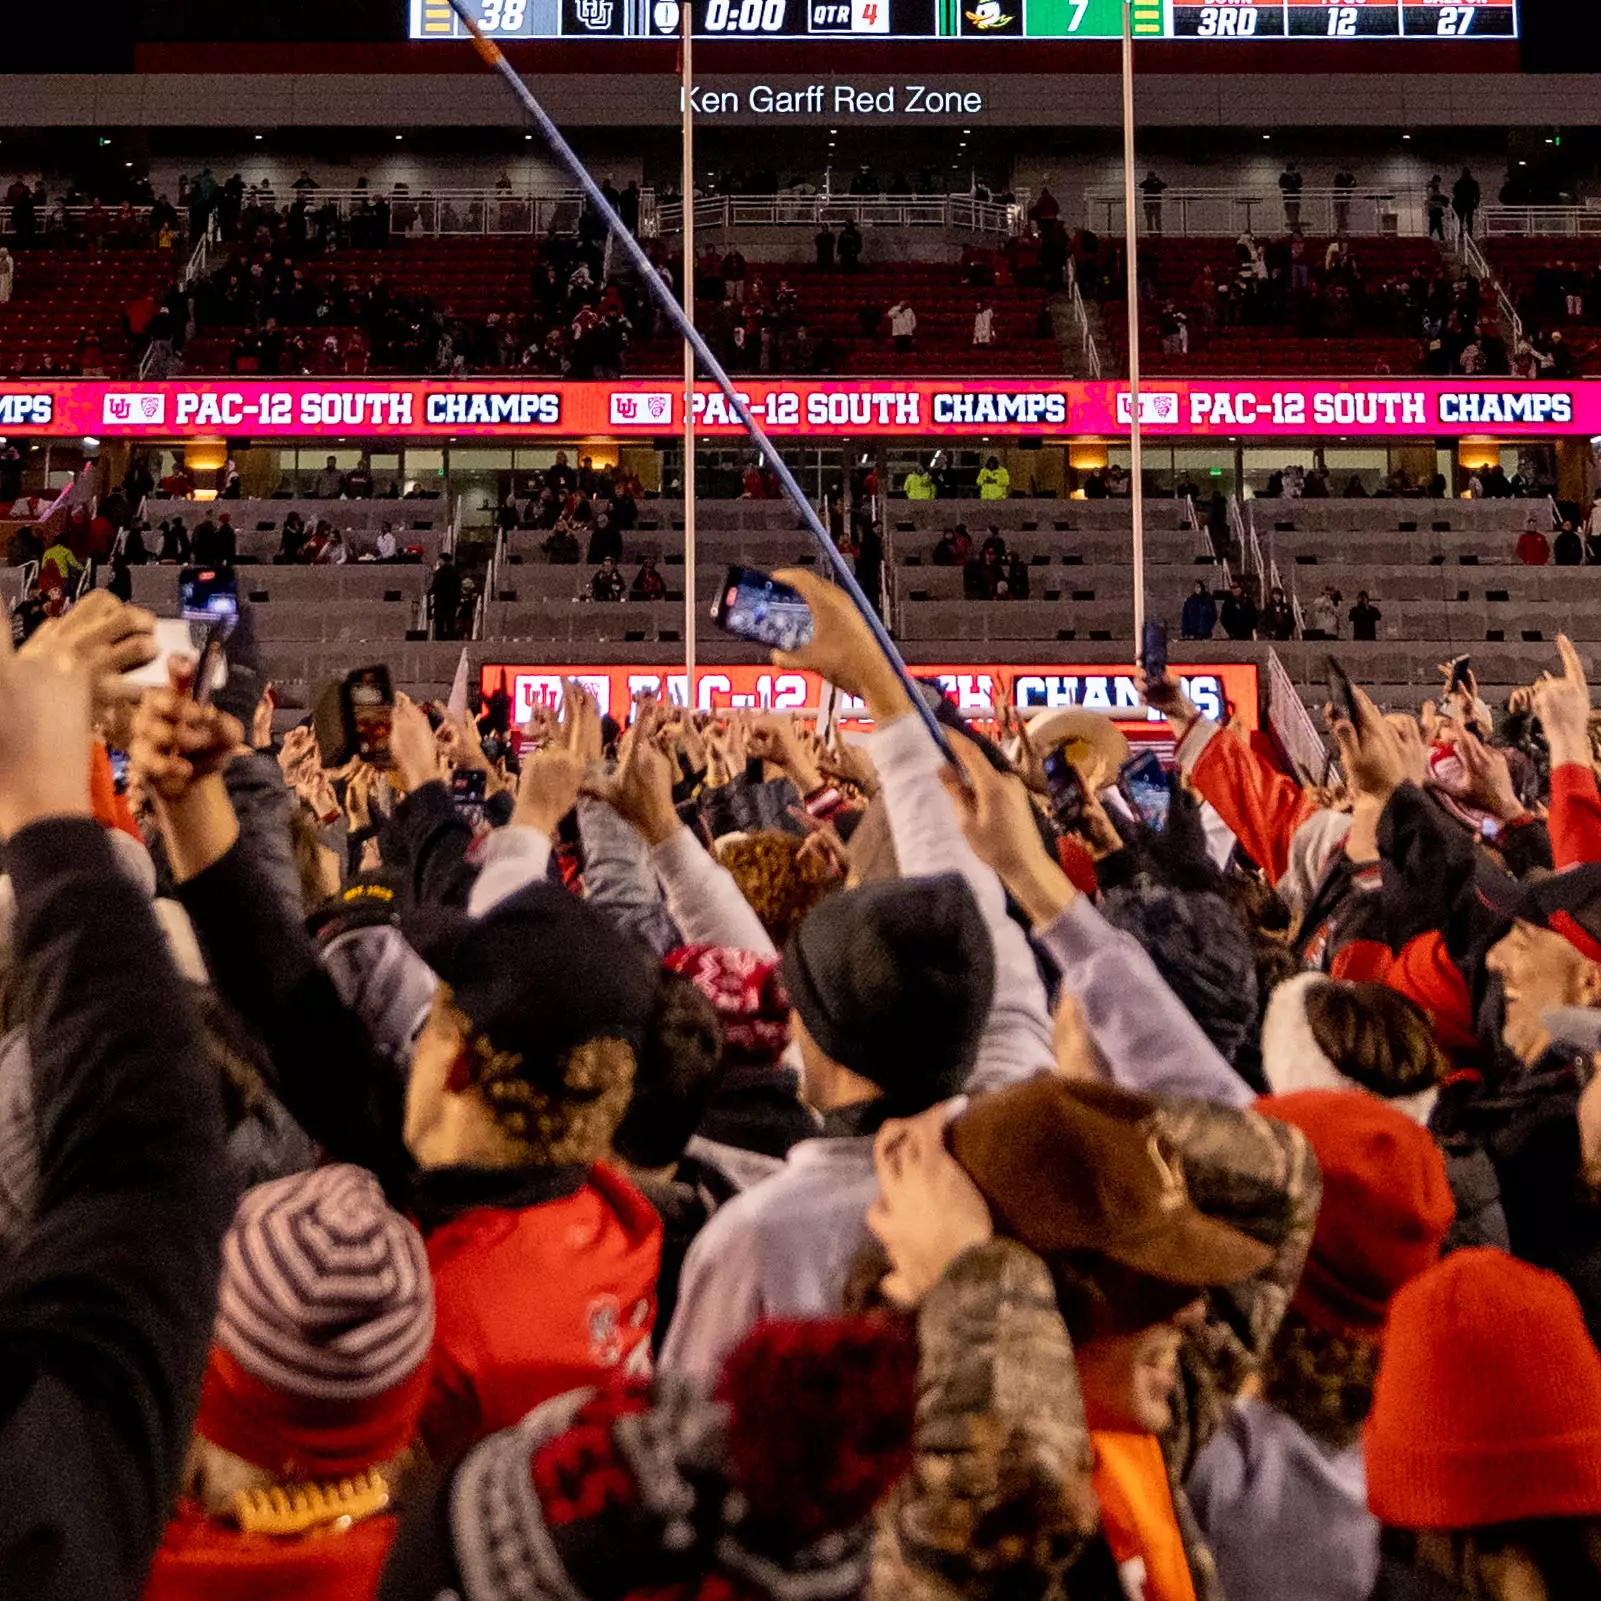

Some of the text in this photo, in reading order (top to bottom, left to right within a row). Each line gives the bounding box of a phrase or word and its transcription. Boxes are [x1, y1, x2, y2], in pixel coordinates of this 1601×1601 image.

[813, 3, 878, 25] QTR 4
[1197, 7, 1258, 37] 3RD
[1327, 7, 1358, 36] 12
[1436, 6, 1476, 36] 27
[680, 85, 983, 113] Ken Garff Red Zone
[175, 393, 292, 424] PAC-12
[300, 393, 413, 424] SOUTH
[427, 394, 559, 423] CHAMPS
[807, 393, 920, 424] SOUTH
[934, 394, 1065, 422] CHAMPS
[1190, 393, 1305, 423] PAC-12
[1313, 393, 1426, 423] SOUTH
[1439, 394, 1571, 422] CHAMPS
[1016, 676, 1220, 722] CHAMS
